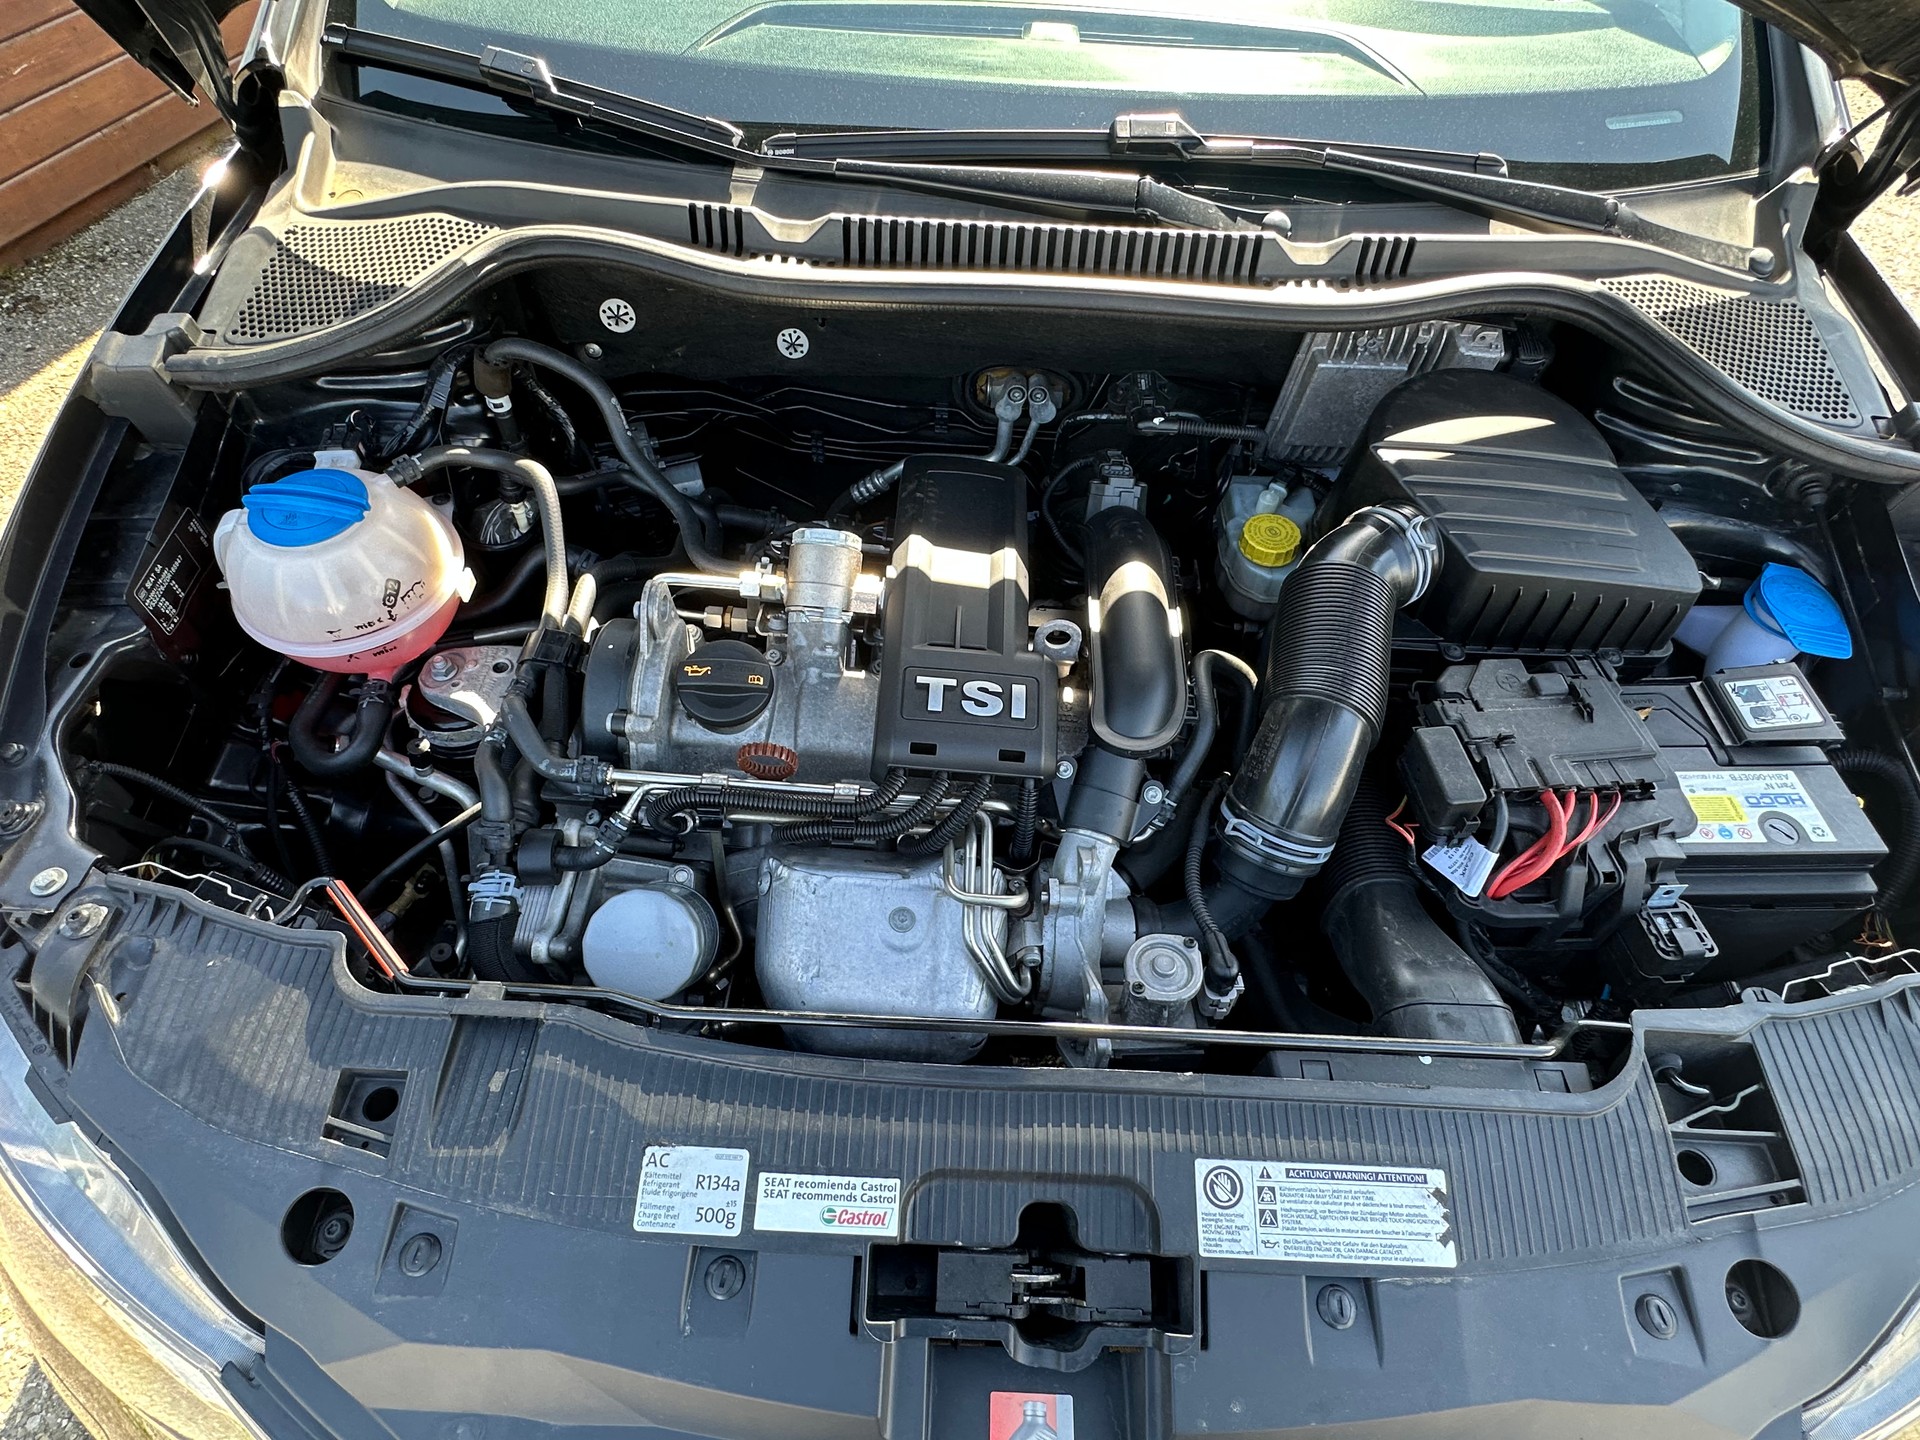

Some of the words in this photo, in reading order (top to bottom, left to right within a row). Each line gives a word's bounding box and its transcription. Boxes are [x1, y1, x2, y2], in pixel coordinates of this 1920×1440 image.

[145, 573, 156, 590] SEAT
[386, 580, 399, 608] G12
[916, 676, 1026, 719] TSI
[1744, 794, 1806, 806] HOCO
[646, 1152, 670, 1168] AC
[696, 1174, 740, 1192] R134a
[1288, 1169, 1332, 1179] ACHTUNG!
[1333, 1170, 1376, 1180] WARNING!
[1378, 1172, 1425, 1182] ATTENTION!
[643, 1180, 680, 1189] Refrigerant
[764, 1177, 792, 1188] SEAT
[794, 1180, 856, 1190] recomienda
[861, 1182, 897, 1192] Castrol
[763, 1188, 790, 1199] SEAT
[792, 1190, 858, 1202] recommends
[860, 1193, 896, 1204] Castrol
[640, 1202, 675, 1212] Füllmenge
[638, 1211, 661, 1220] Charge
[695, 1207, 736, 1230] 500g
[838, 1208, 888, 1226] Castrol
[636, 1220, 676, 1228] Contenance
